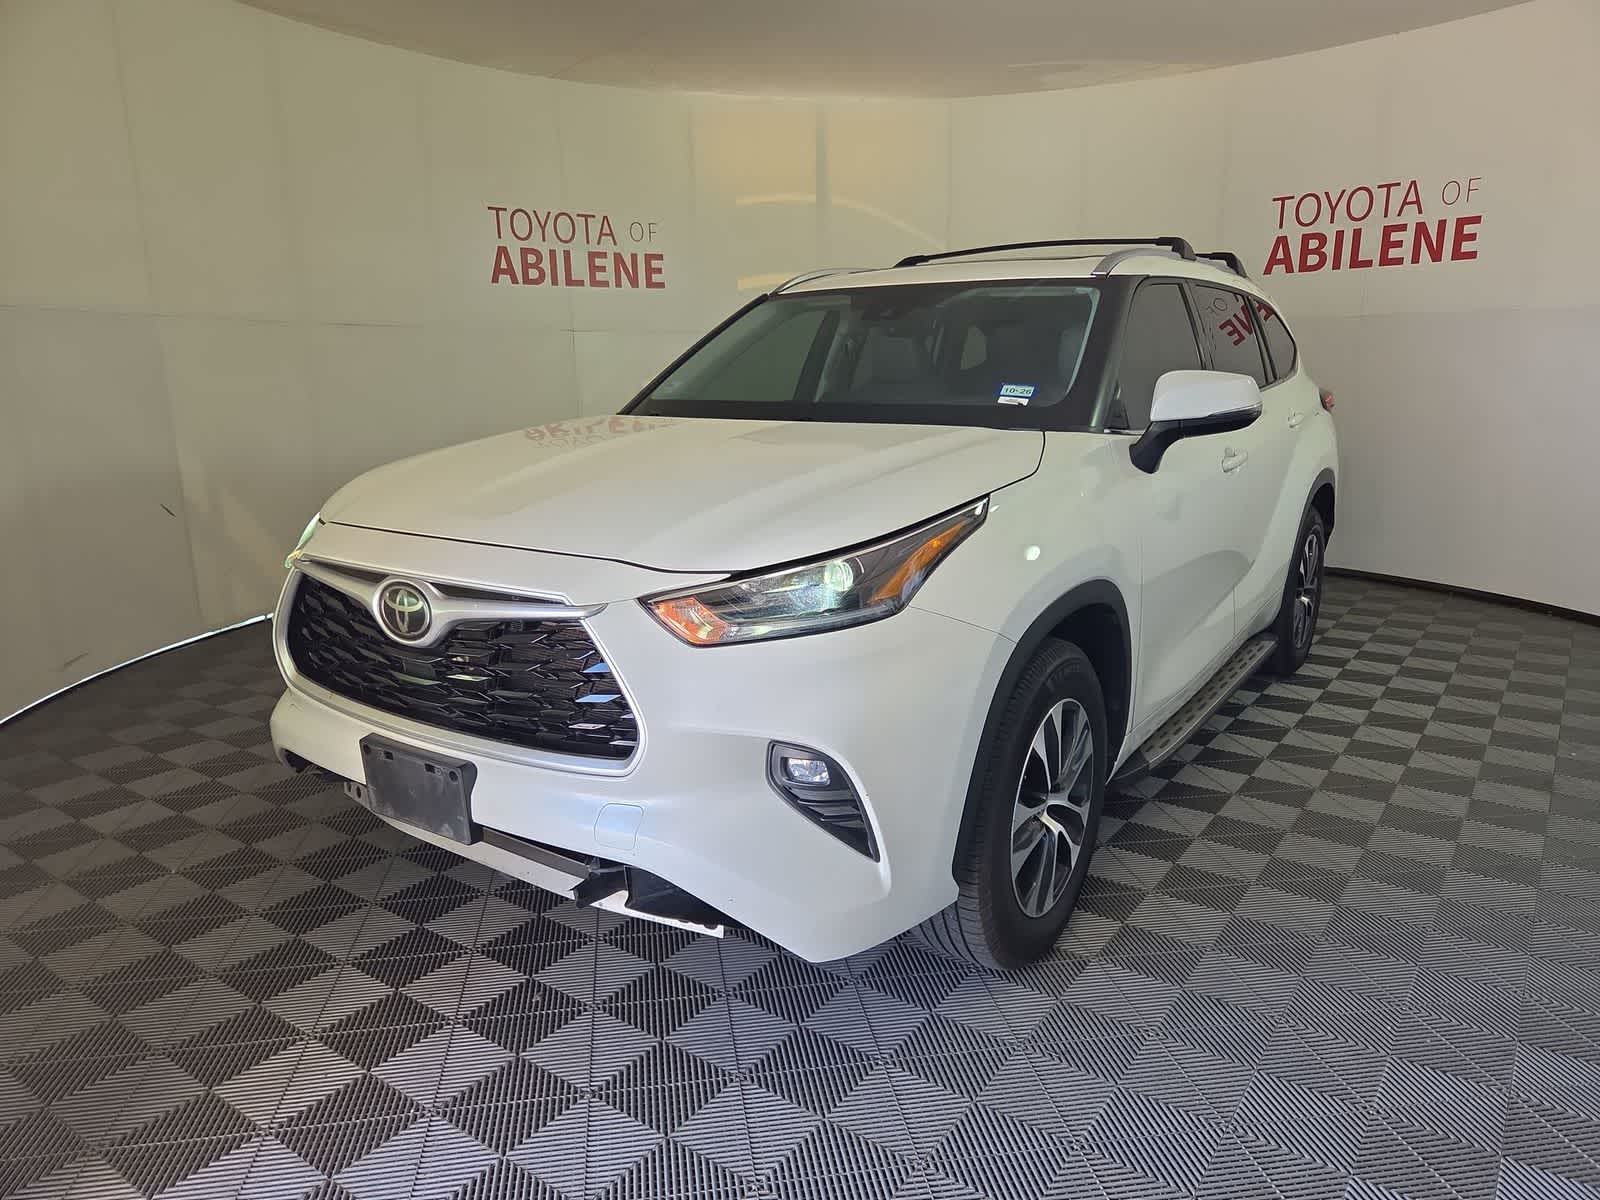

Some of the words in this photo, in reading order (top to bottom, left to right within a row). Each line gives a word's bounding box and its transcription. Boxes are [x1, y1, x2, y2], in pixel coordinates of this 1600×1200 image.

[487, 206, 617, 246] TOYOTA
[629, 221, 657, 242] OF
[1272, 179, 1424, 230] TOYOTA
[1441, 177, 1482, 206] OF
[491, 245, 666, 289] ABILENE
[1262, 215, 1483, 276] ABILENE
